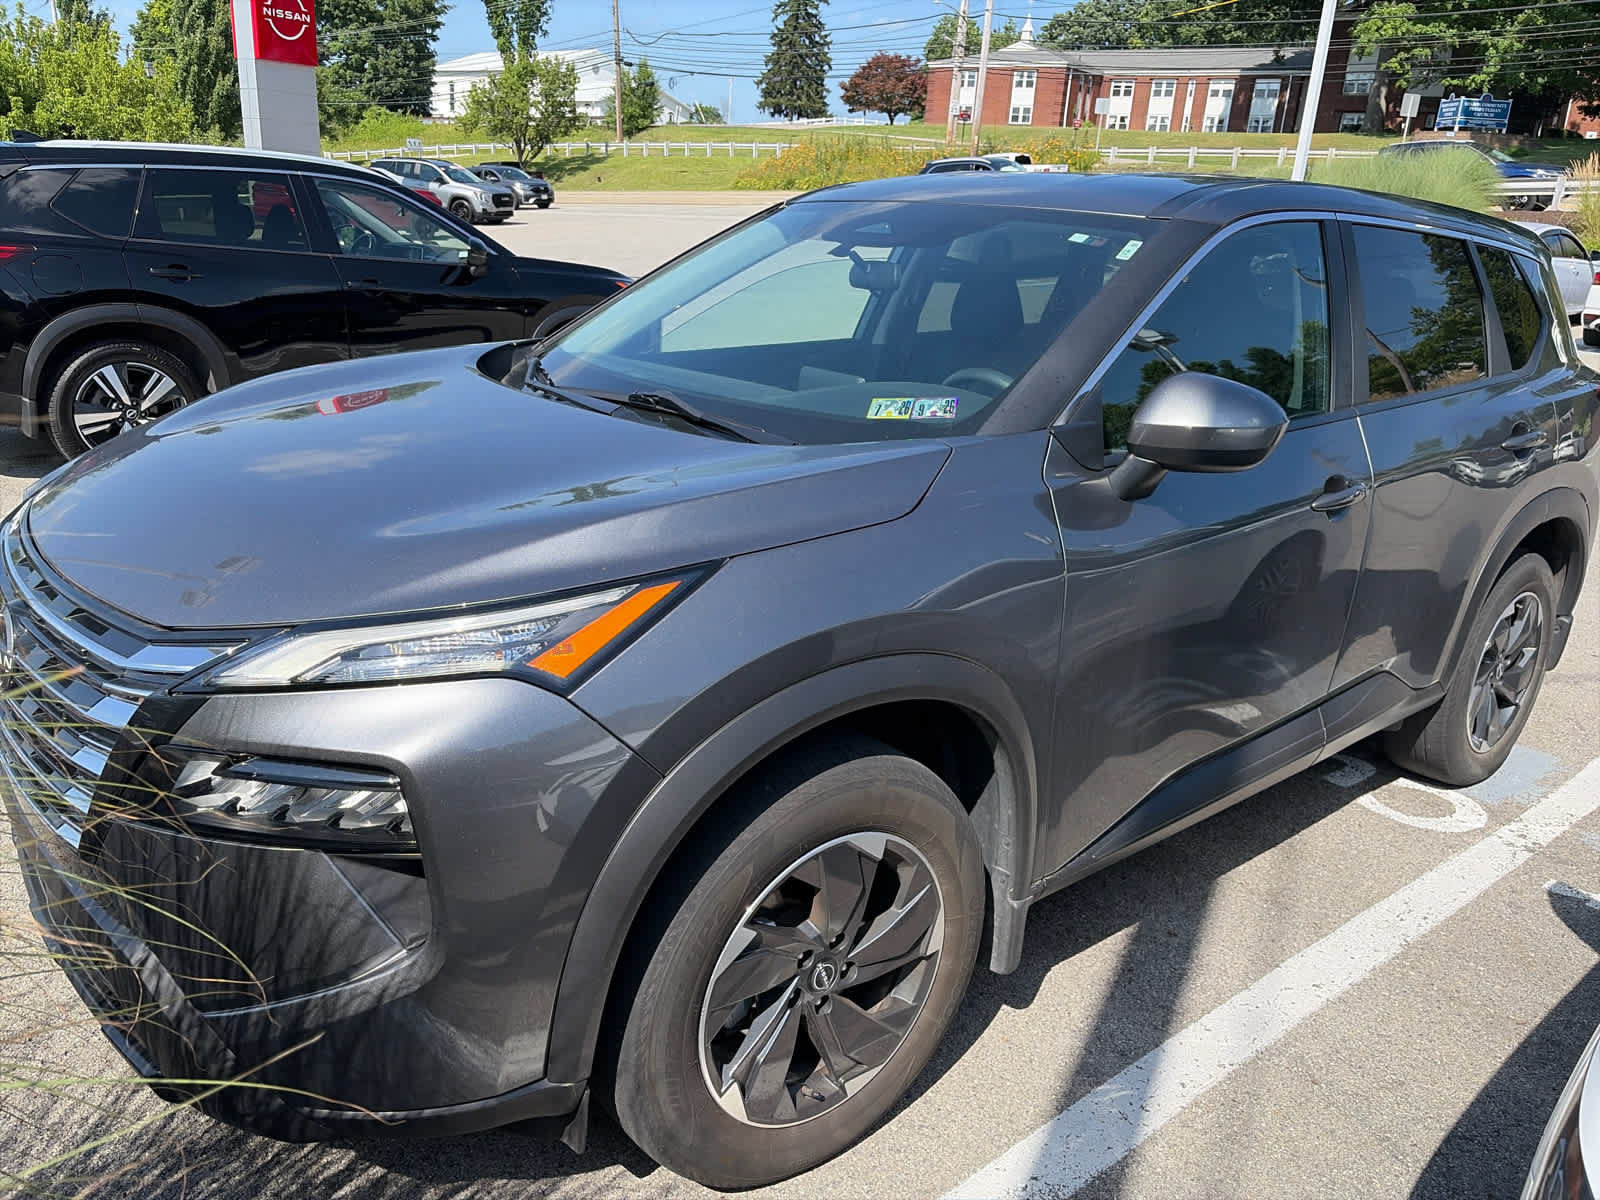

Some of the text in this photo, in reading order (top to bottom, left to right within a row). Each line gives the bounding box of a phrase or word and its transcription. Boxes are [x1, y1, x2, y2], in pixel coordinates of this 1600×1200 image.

[263, 7, 311, 23] NISSAN
[874, 404, 882, 417] 7
[917, 404, 925, 417] 9
